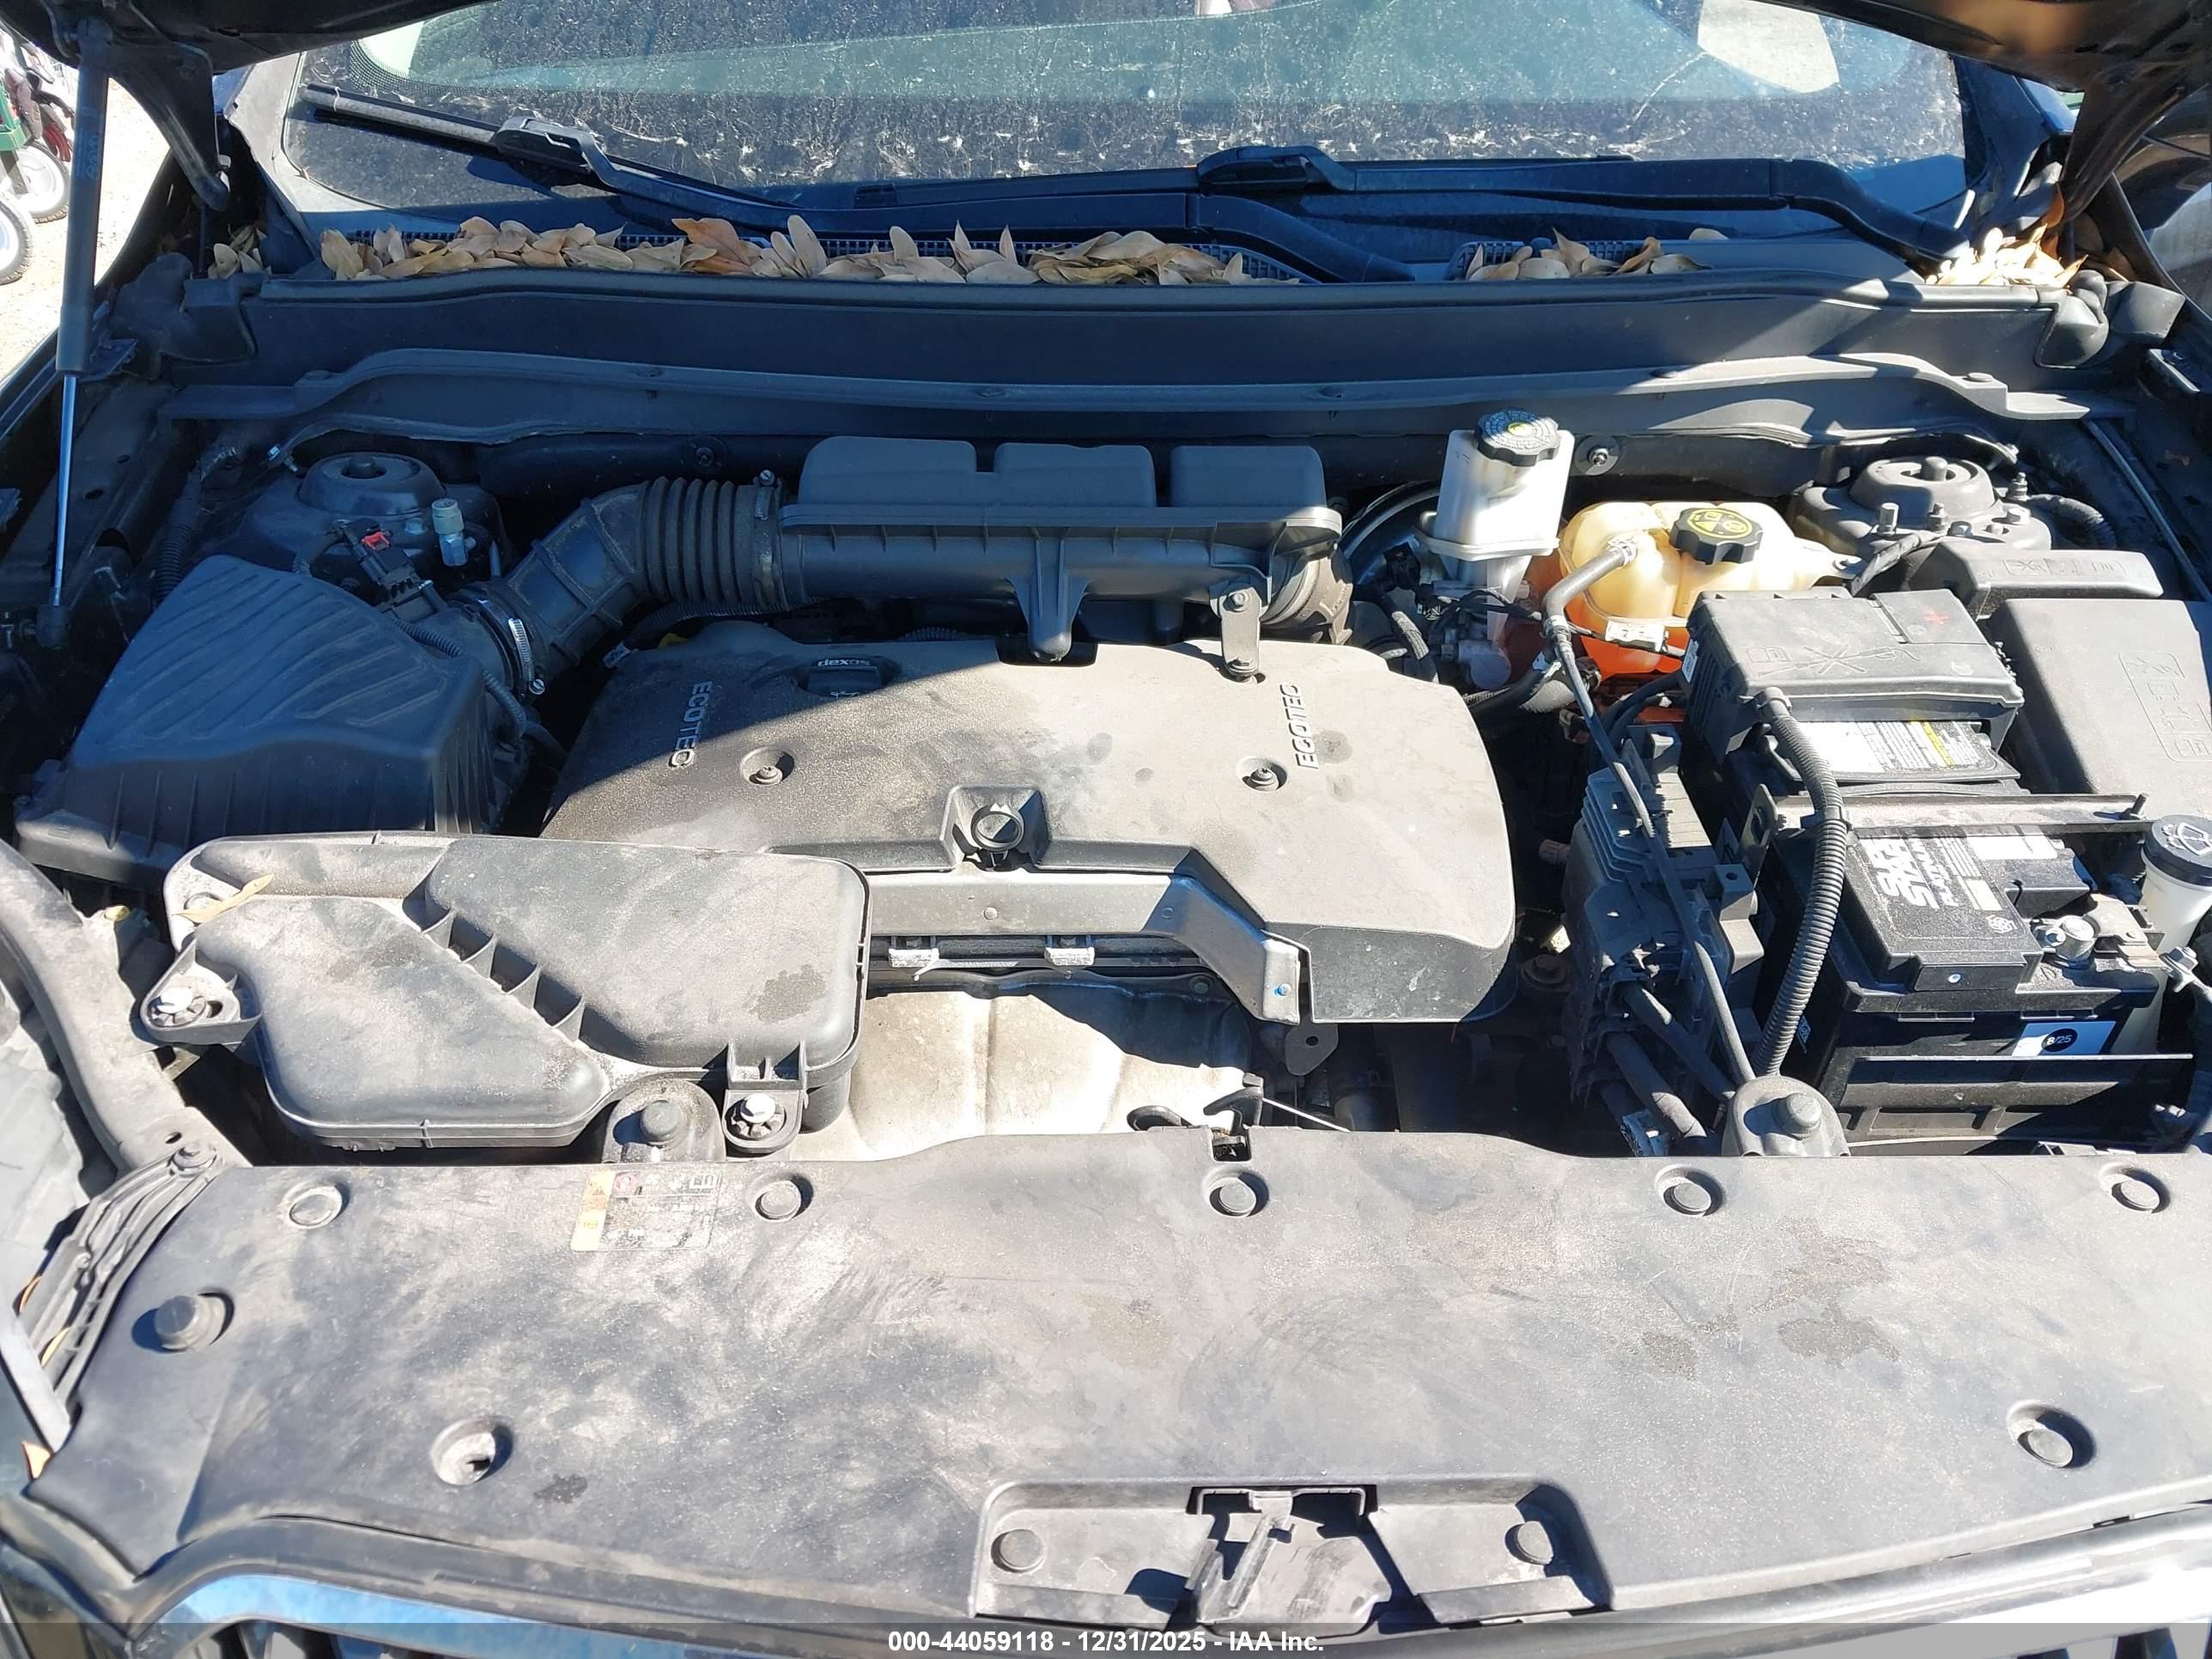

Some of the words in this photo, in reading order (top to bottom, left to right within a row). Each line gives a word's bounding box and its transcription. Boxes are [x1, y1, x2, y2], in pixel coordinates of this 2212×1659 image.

[817, 659, 871, 667] dexos
[669, 681, 713, 767] ECOTEC
[1279, 684, 1320, 769] ECOTEC
[1859, 838, 1900, 896] SUPE
[1875, 838, 1940, 908] STAR
[2046, 1034, 2073, 1046] 8/25
